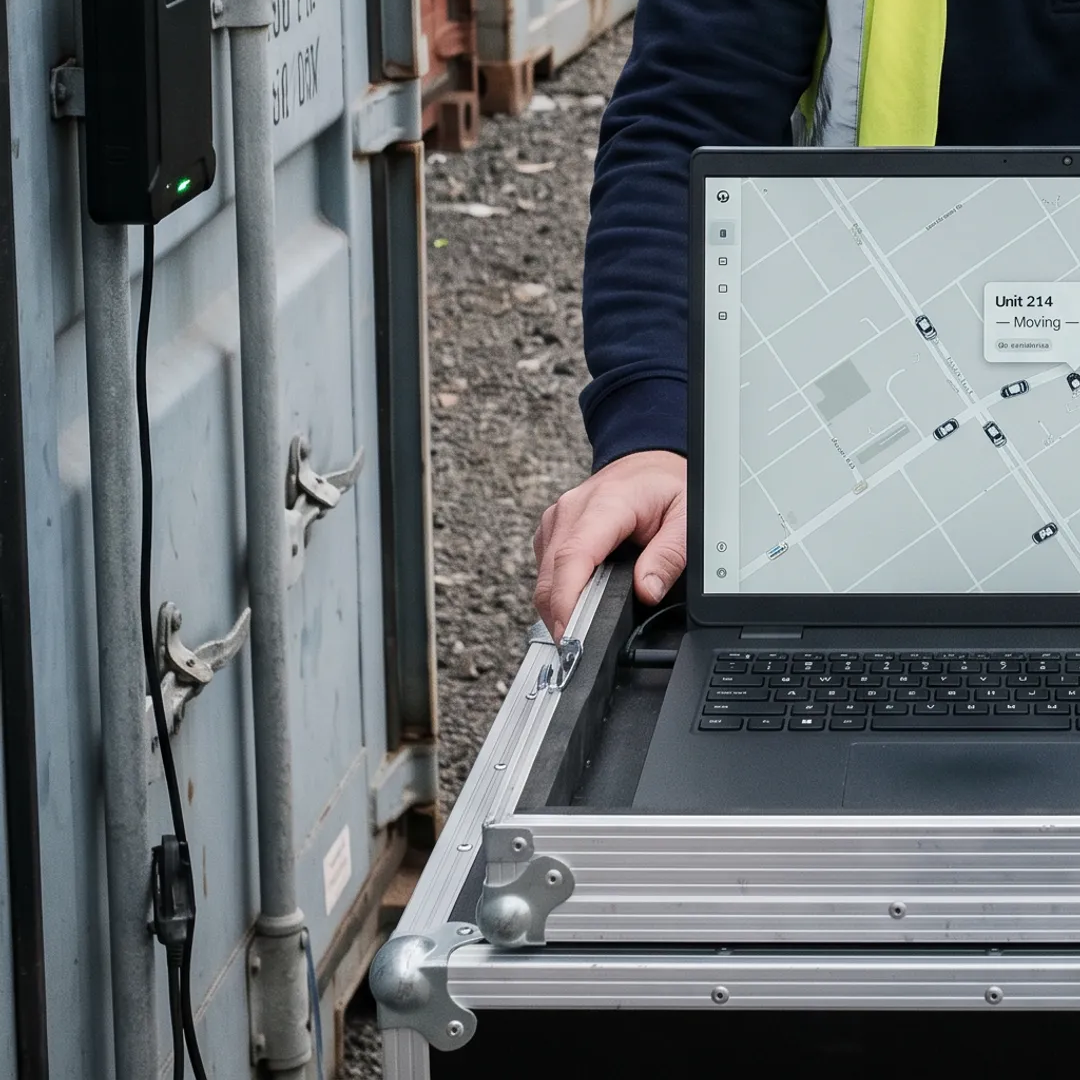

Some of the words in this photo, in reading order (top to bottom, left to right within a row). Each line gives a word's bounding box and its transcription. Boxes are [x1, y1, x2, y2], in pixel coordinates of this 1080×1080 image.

[995, 295, 1023, 308] Unit
[1026, 295, 1053, 308] 214
[1014, 316, 1061, 331] Moving
